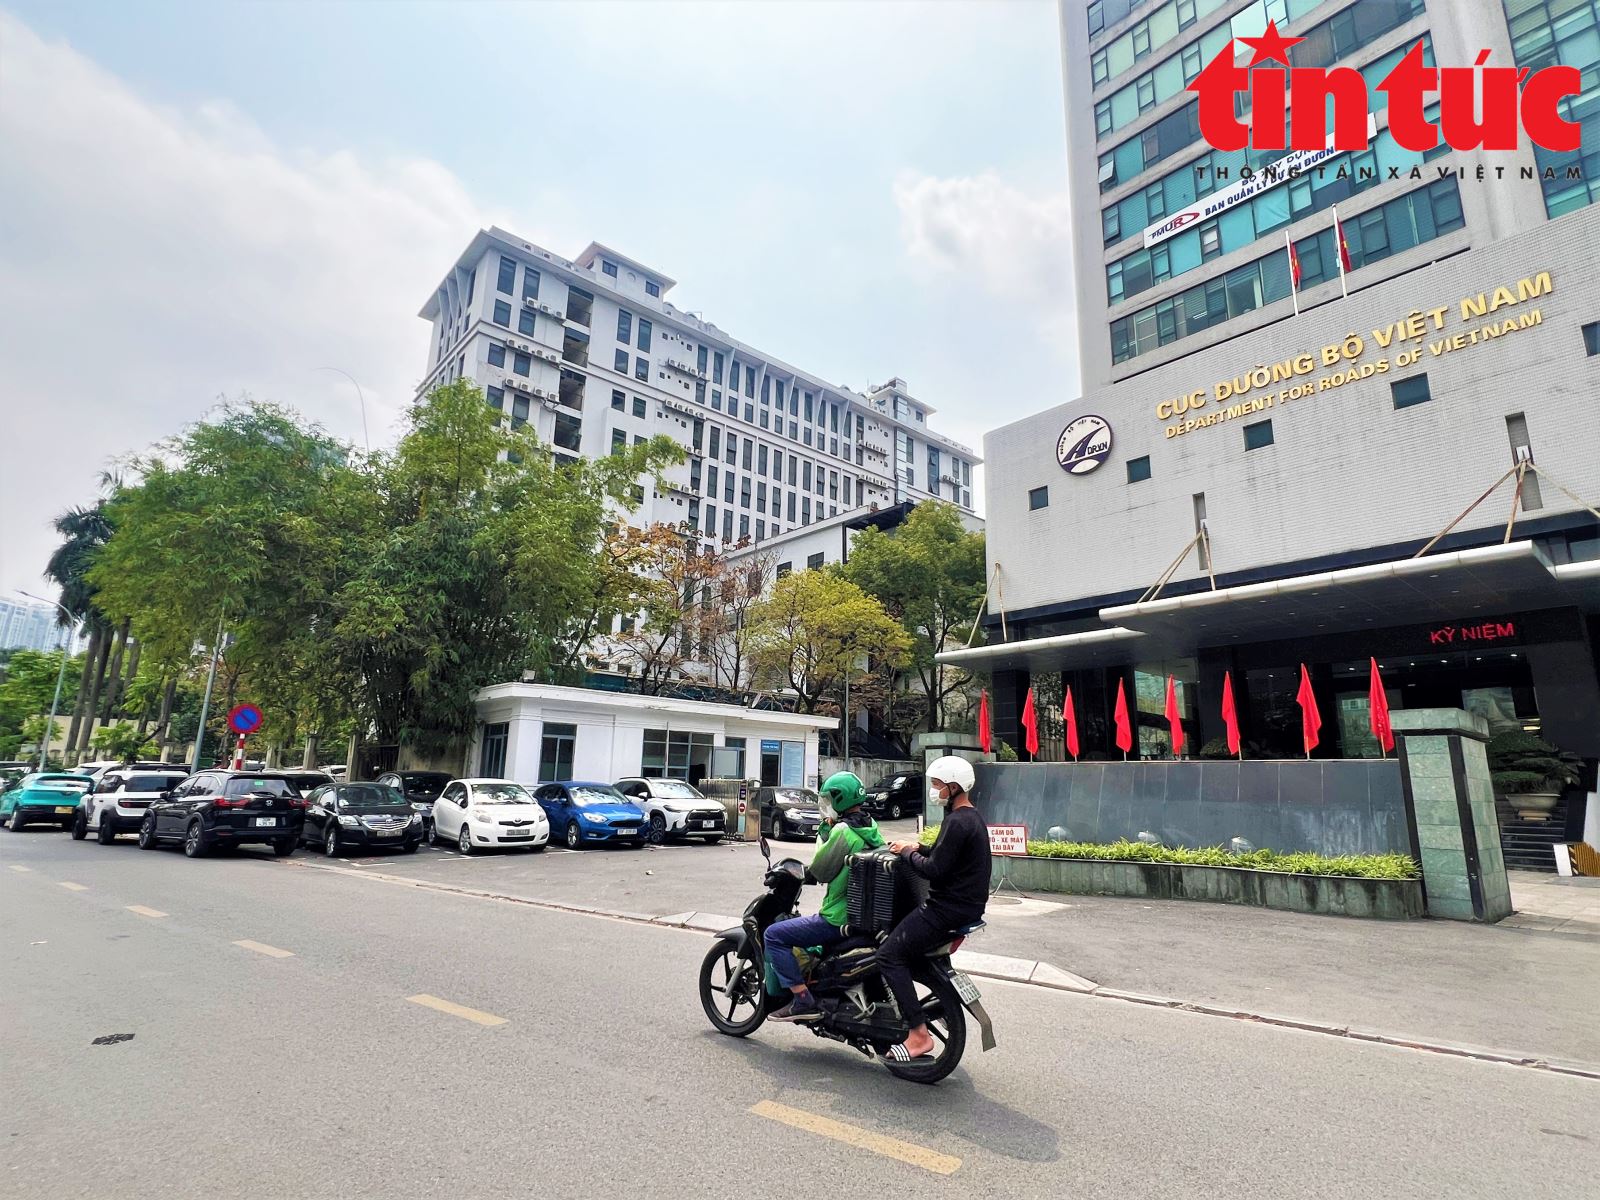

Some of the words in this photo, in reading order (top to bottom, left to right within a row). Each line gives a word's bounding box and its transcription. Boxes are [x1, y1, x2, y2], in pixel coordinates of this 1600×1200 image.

[1205, 200, 1225, 216] BAN
[1227, 186, 1254, 205] QUẢN
[1156, 388, 1207, 421] CỤC
[1214, 353, 1315, 402] ĐƯỜNG
[1321, 332, 1364, 367] BỘ
[1372, 306, 1449, 348] VIỆT
[1460, 271, 1553, 321] NAM
[1165, 394, 1275, 439] DEPARTMENT
[1279, 382, 1315, 405] FOR
[1319, 358, 1390, 391] ROADS
[1395, 347, 1423, 368] OF
[1429, 309, 1543, 356] VIETNAM
